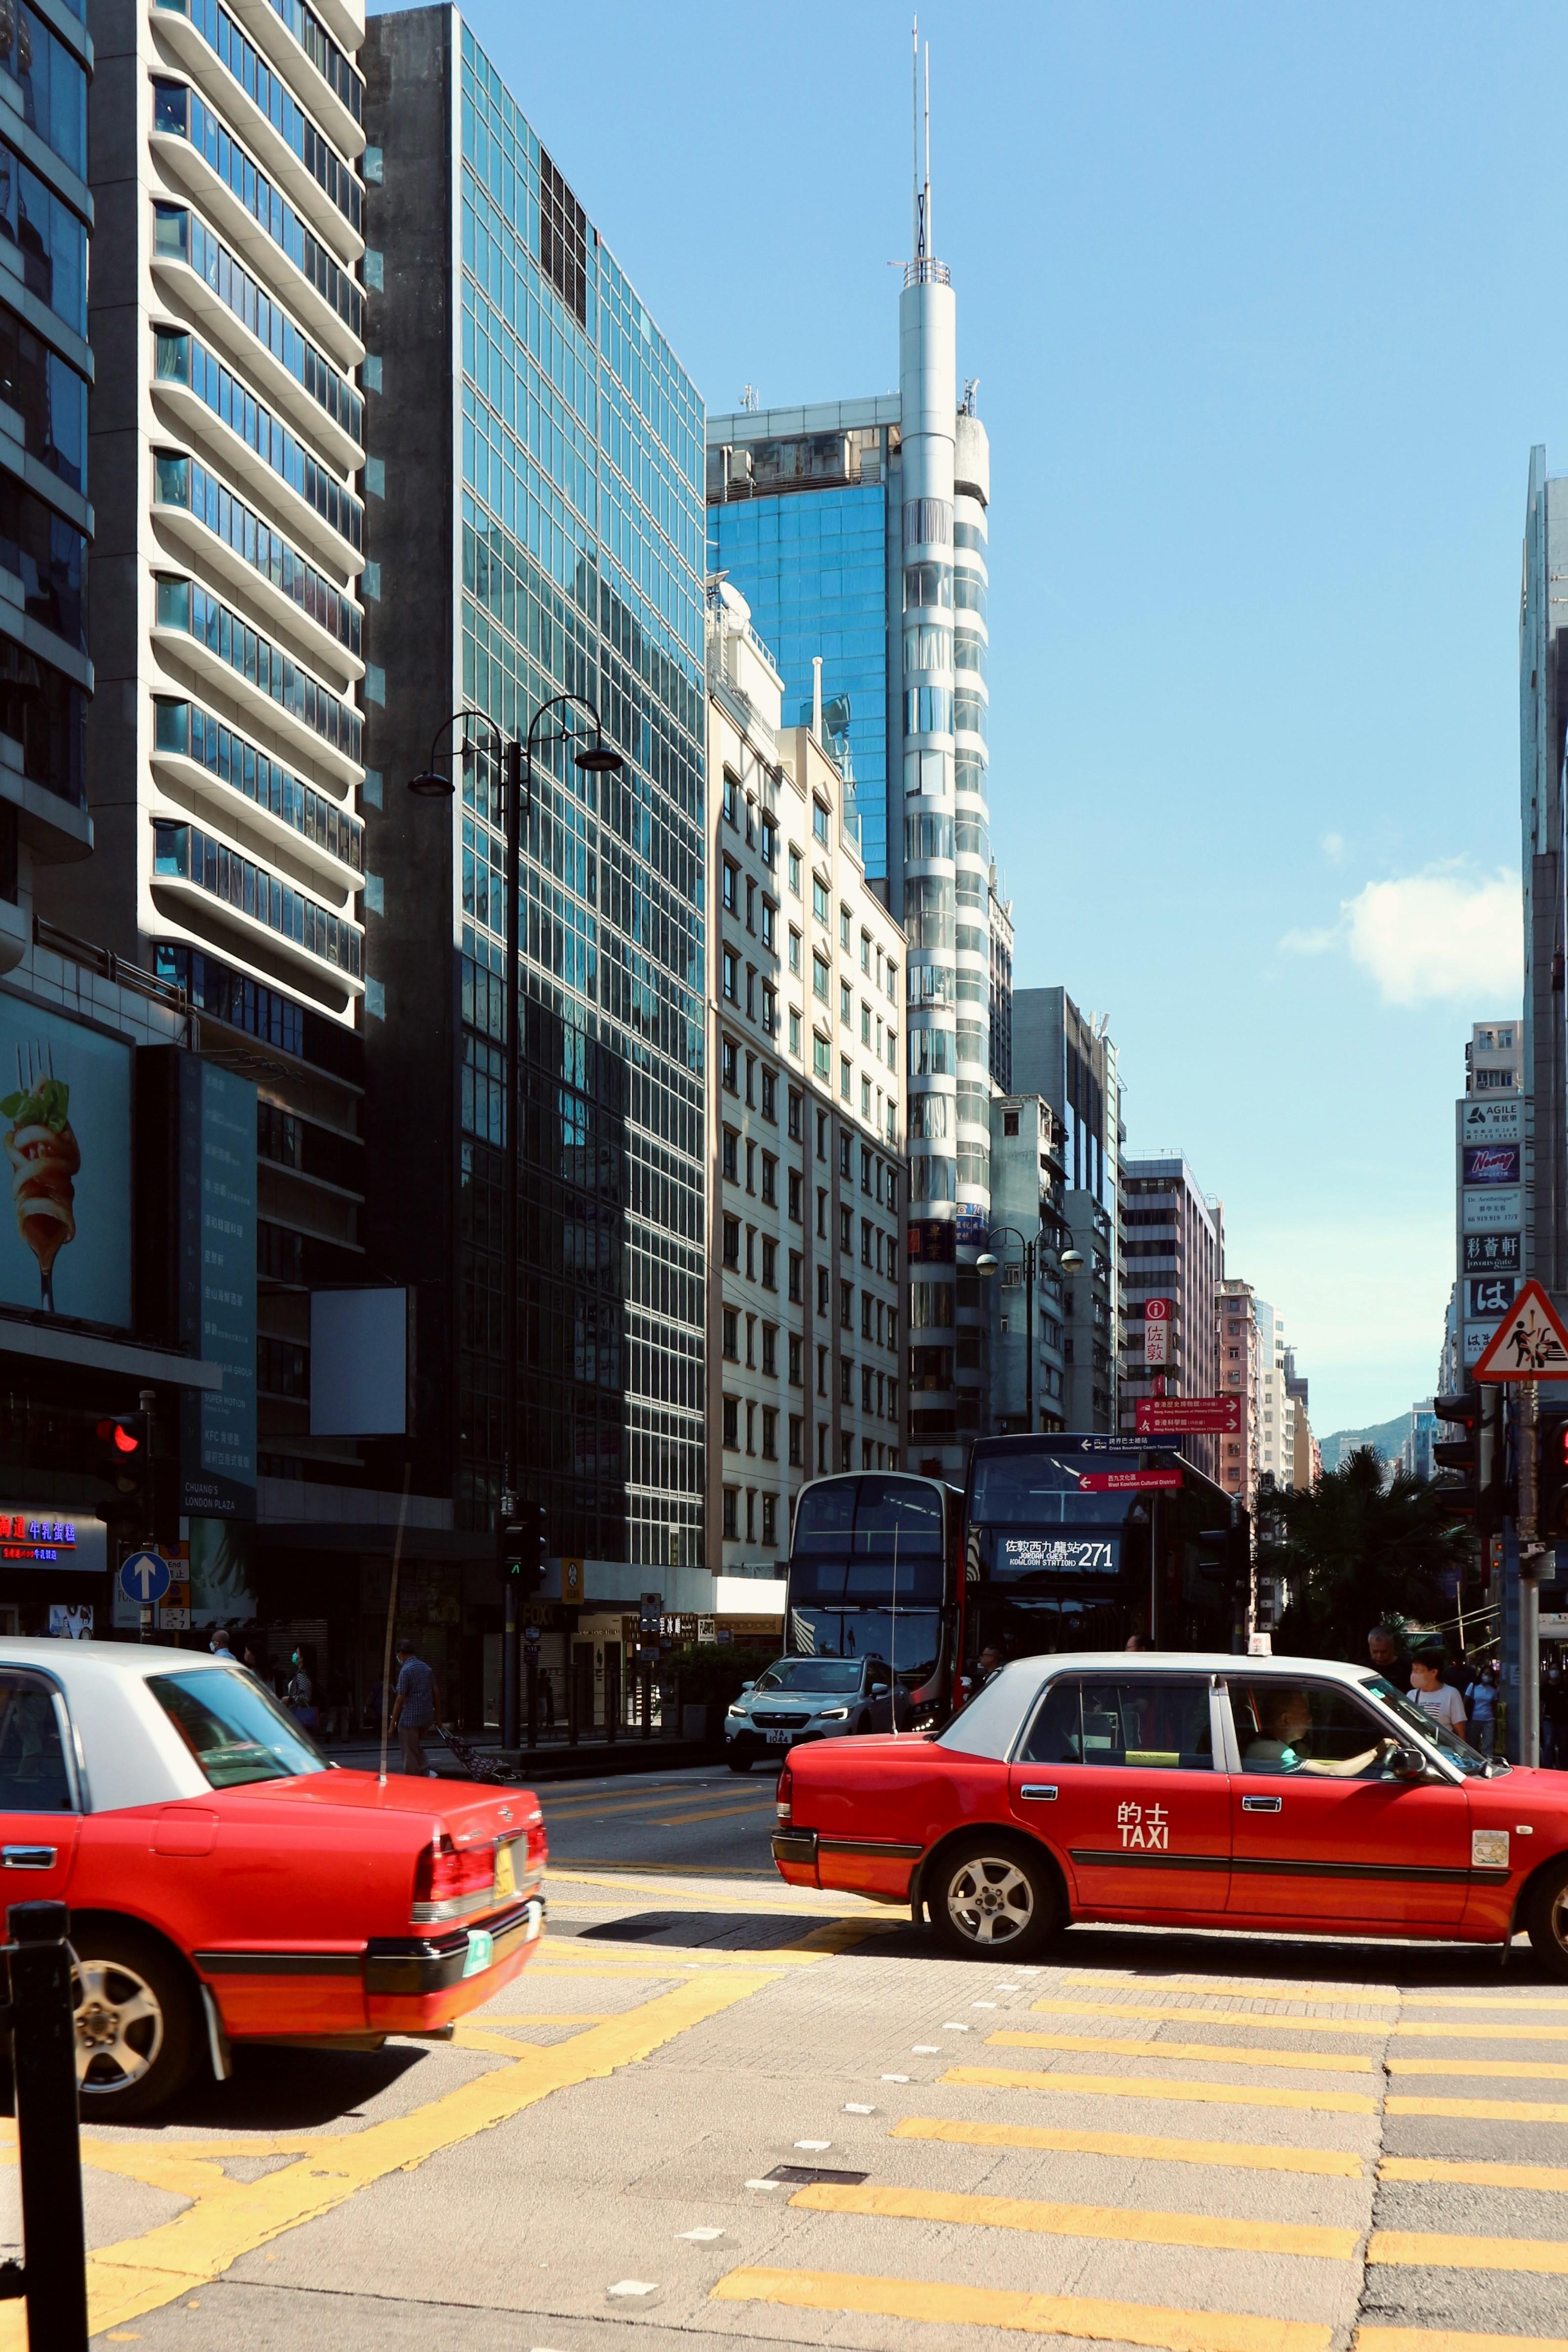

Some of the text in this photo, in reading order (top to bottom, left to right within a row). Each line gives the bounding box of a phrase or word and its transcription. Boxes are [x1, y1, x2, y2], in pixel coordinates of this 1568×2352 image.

[1486, 1105, 1517, 1114] AGILE
[1472, 1151, 1515, 1173] Neway
[1467, 1237, 1518, 1258] 彩薈軒
[1467, 1258, 1512, 1269] joyous gate
[205, 1285, 243, 1306] 金山海鮮酒家
[1477, 1281, 1509, 1310] は
[1147, 1326, 1163, 1360] 佐敦
[233, 1367, 253, 1377] GROUP
[205, 1393, 246, 1408] SUPER MOTION
[205, 1430, 240, 1445] KFC 肯德基
[185, 1482, 218, 1495] CHUANG'S
[185, 1497, 235, 1510] LONDON PLAZA
[29, 1520, 75, 1542] 牛乳蛋糕
[1005, 1540, 1113, 1567] 佐敦西九龍站 271
[1117, 1801, 1169, 1825] 的士
[1117, 1824, 1169, 1849] TAXI
